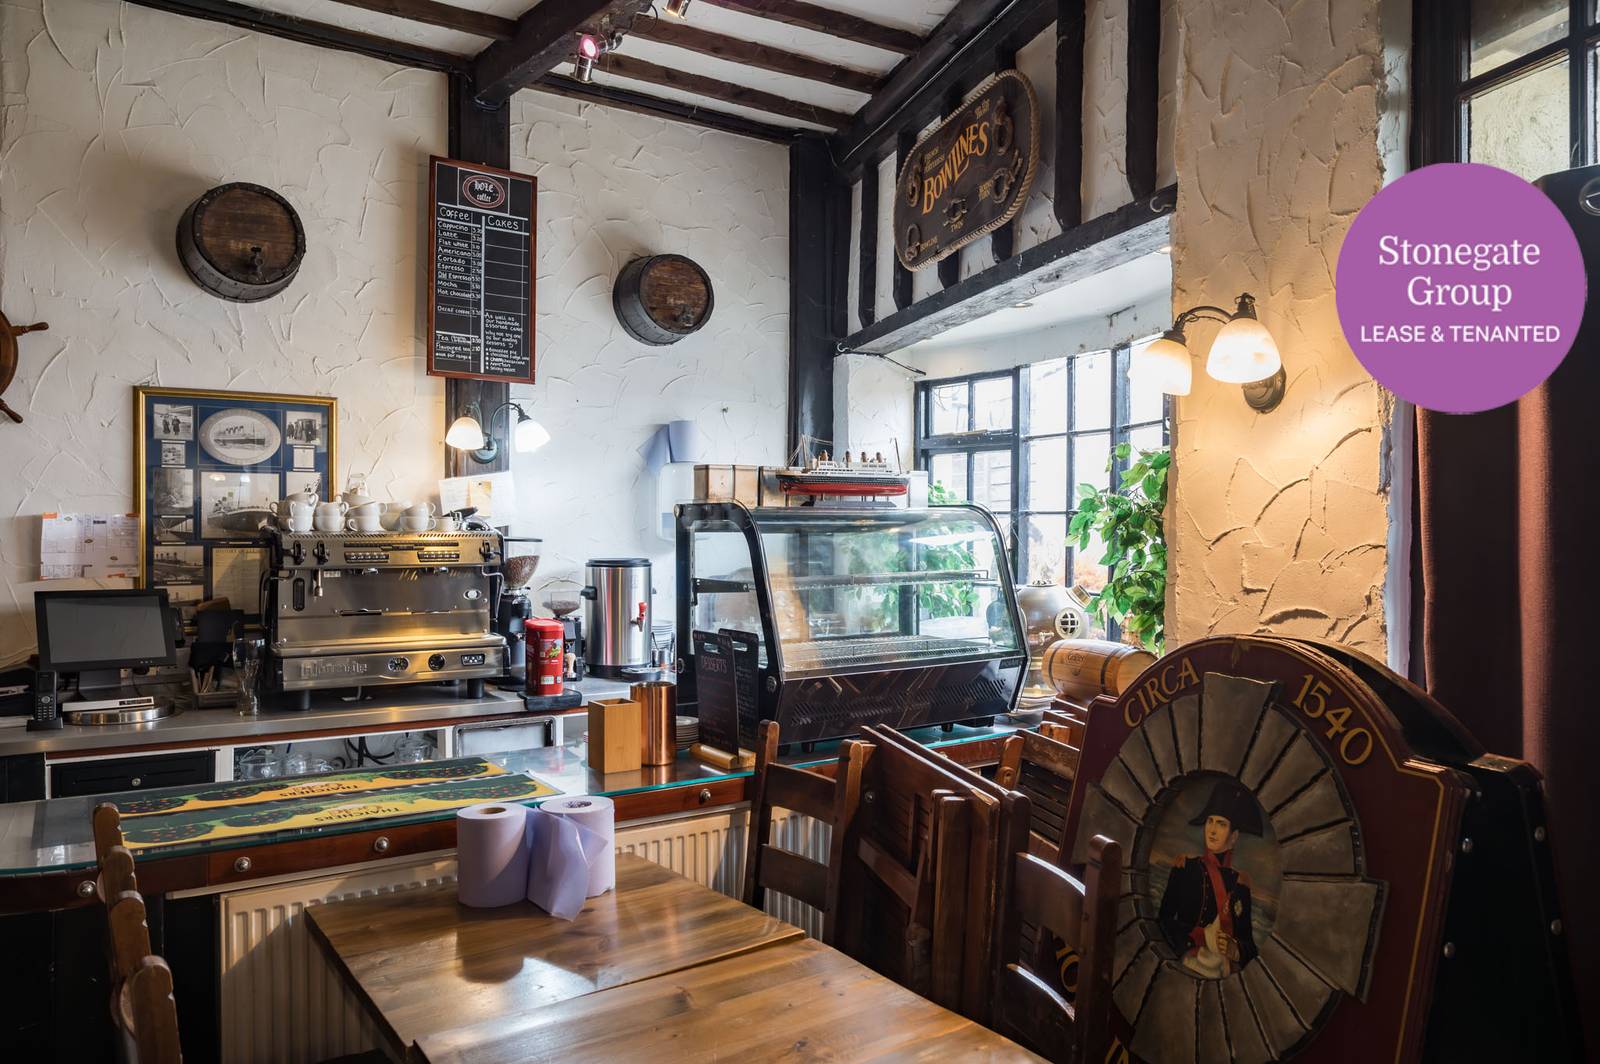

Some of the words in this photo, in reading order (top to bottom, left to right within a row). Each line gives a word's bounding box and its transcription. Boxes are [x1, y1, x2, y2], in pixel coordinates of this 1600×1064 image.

[921, 122, 990, 215] BOWLINES
[440, 207, 470, 221] Coffee
[488, 216, 519, 230] Cakes
[438, 238, 452, 246] Flat
[438, 247, 472, 257] Americano
[437, 254, 466, 265] Cortado
[437, 263, 465, 272] Espresso
[438, 280, 458, 289] Mocha
[1123, 656, 1201, 729] CIRCA
[1291, 673, 1374, 767] 1540
[279, 784, 359, 798] THATCHERS
[314, 808, 400, 822] THATCHERS
